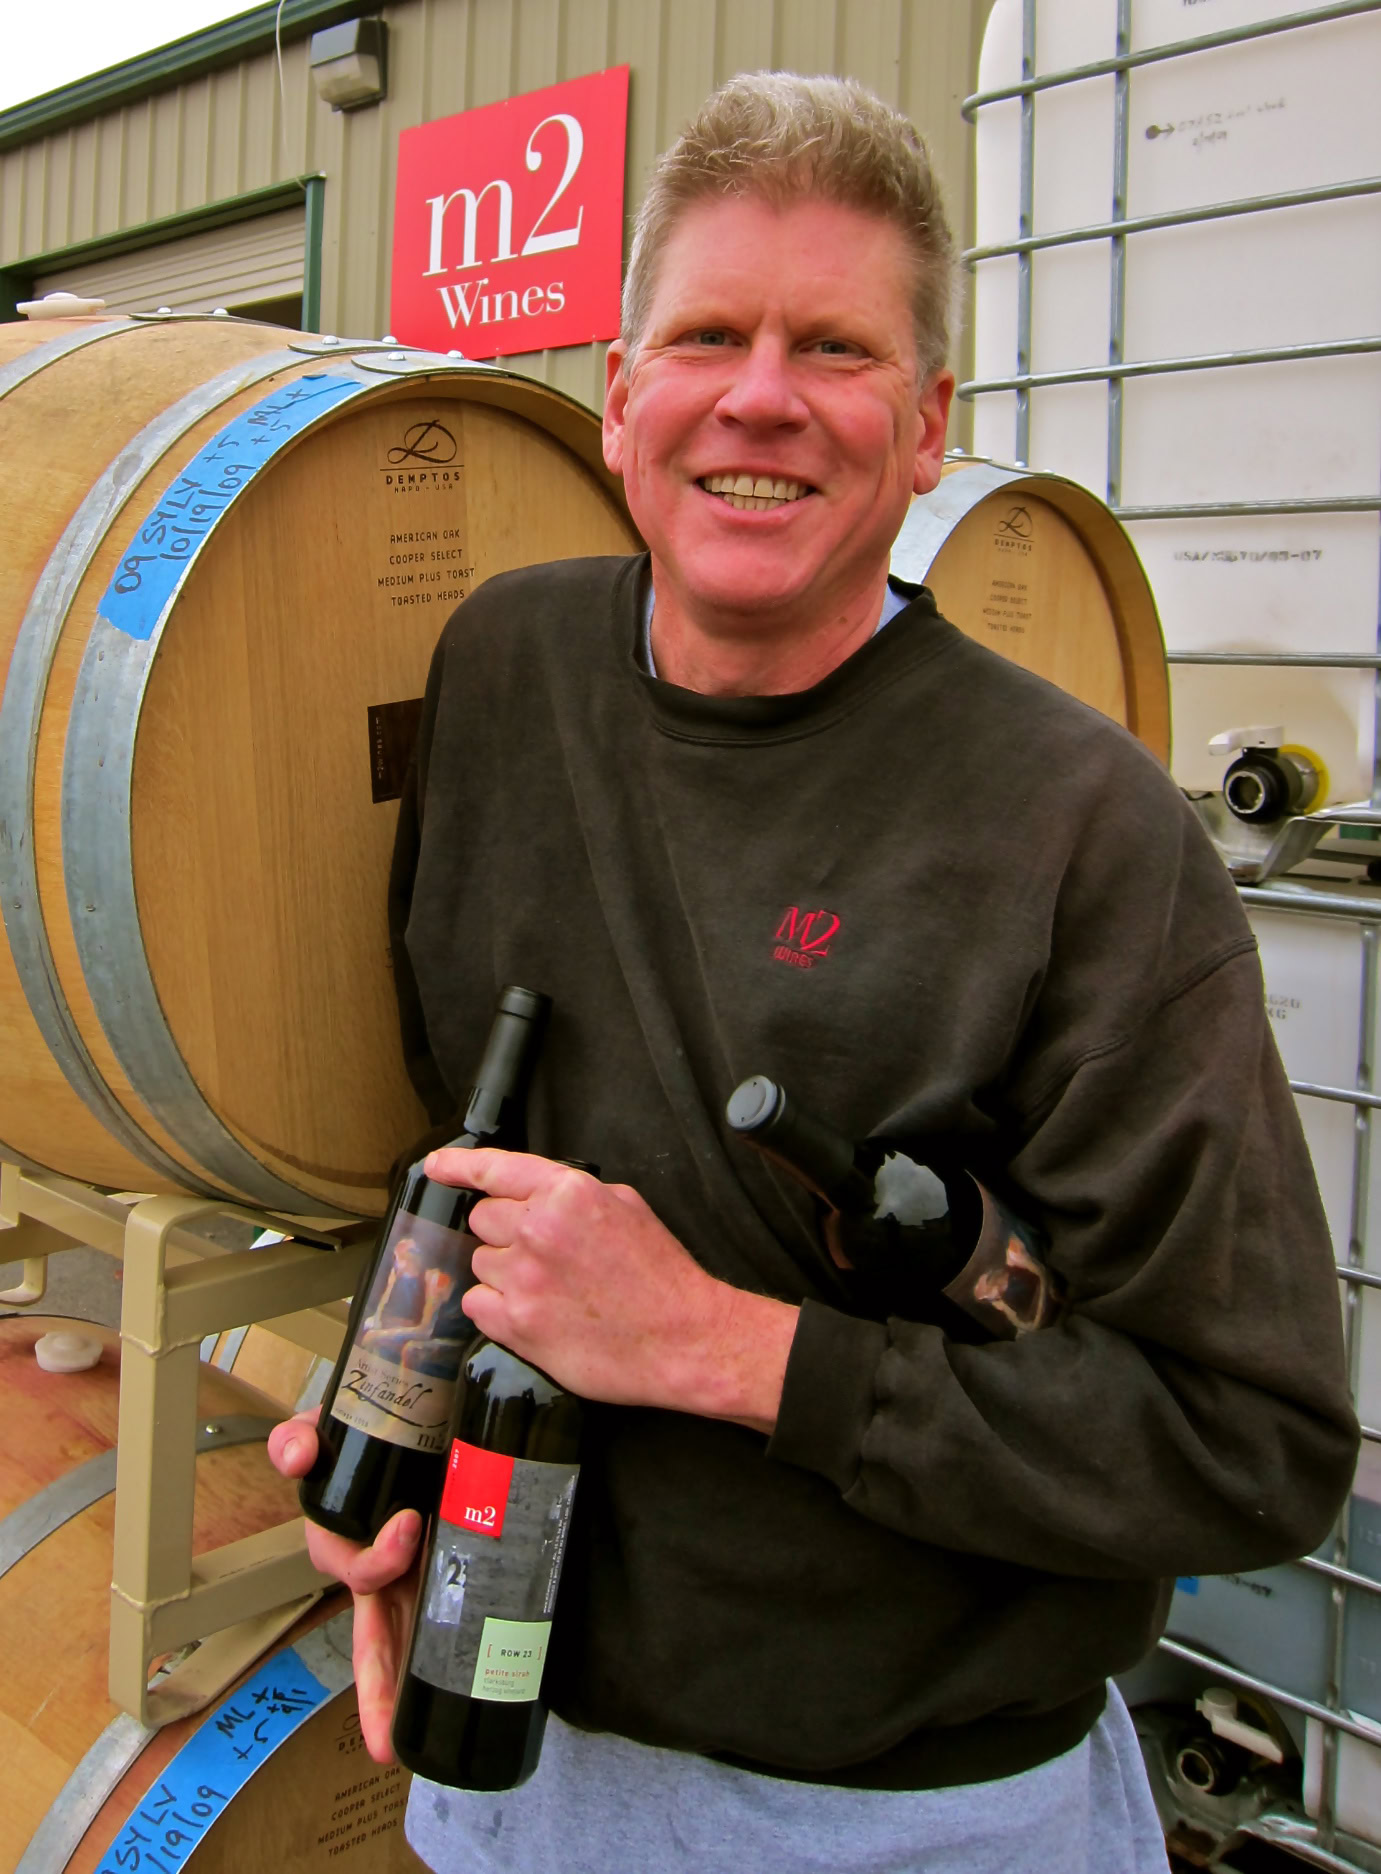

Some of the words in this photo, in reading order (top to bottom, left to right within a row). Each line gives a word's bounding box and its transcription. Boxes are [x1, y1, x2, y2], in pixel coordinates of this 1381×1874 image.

[422, 113, 584, 276] m2
[436, 278, 566, 330] Wines
[386, 472, 460, 486] DEMPTOS
[160, 464, 256, 560] 10/19/09
[390, 530, 438, 544] AMERICAN
[442, 529, 460, 540] OAK
[114, 555, 157, 594] 09
[389, 552, 425, 565] COOPER
[431, 549, 463, 561] SELECT
[377, 574, 414, 587] MEDIUM
[419, 571, 441, 583] PLUS
[446, 567, 475, 579] TOAST
[391, 593, 432, 607] TOASTED
[437, 589, 465, 601] HEADS
[341, 1369, 435, 1412] Zinfandel
[464, 1505, 497, 1527] m2
[500, 1649, 521, 1658] ROW
[523, 1650, 533, 1658] 23
[485, 1668, 509, 1678] petite
[512, 1669, 530, 1678] sirah
[331, 1799, 366, 1822] COOPER
[370, 1782, 401, 1803] SELECT
[335, 1775, 380, 1803] AMERICAN
[384, 1767, 401, 1781] OAK
[317, 1823, 353, 1846] MEDIUM
[356, 1809, 379, 1827] PLUS
[328, 1832, 367, 1858] TOASTED
[371, 1817, 399, 1838] HEADS
